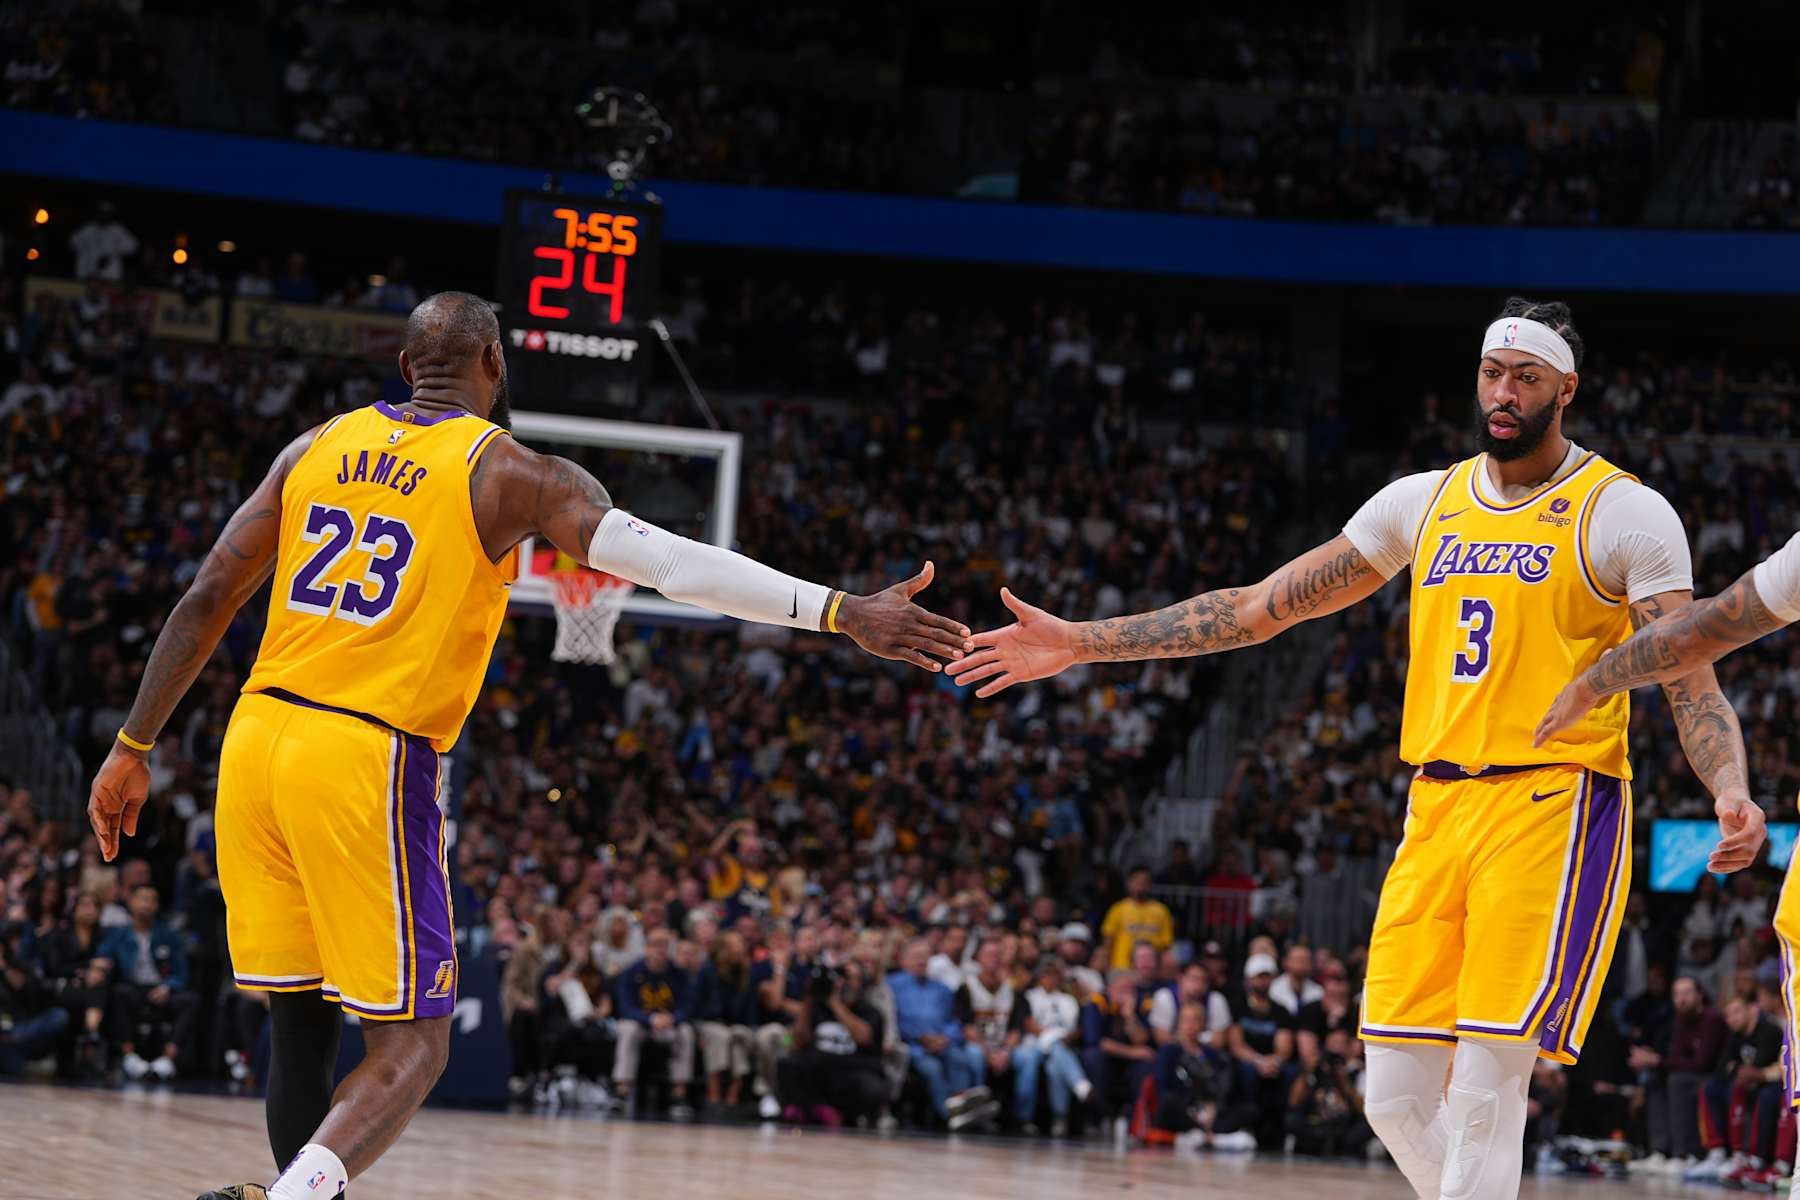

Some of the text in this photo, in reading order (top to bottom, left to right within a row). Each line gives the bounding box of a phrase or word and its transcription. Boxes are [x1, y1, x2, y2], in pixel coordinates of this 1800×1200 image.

[554, 208, 639, 256] 7:55
[528, 246, 626, 325] 24
[544, 331, 639, 361] TISSOT
[336, 450, 427, 496] JAMES
[1538, 512, 1571, 527] bibigo
[286, 501, 416, 628] 23
[1451, 597, 1495, 684] 3
